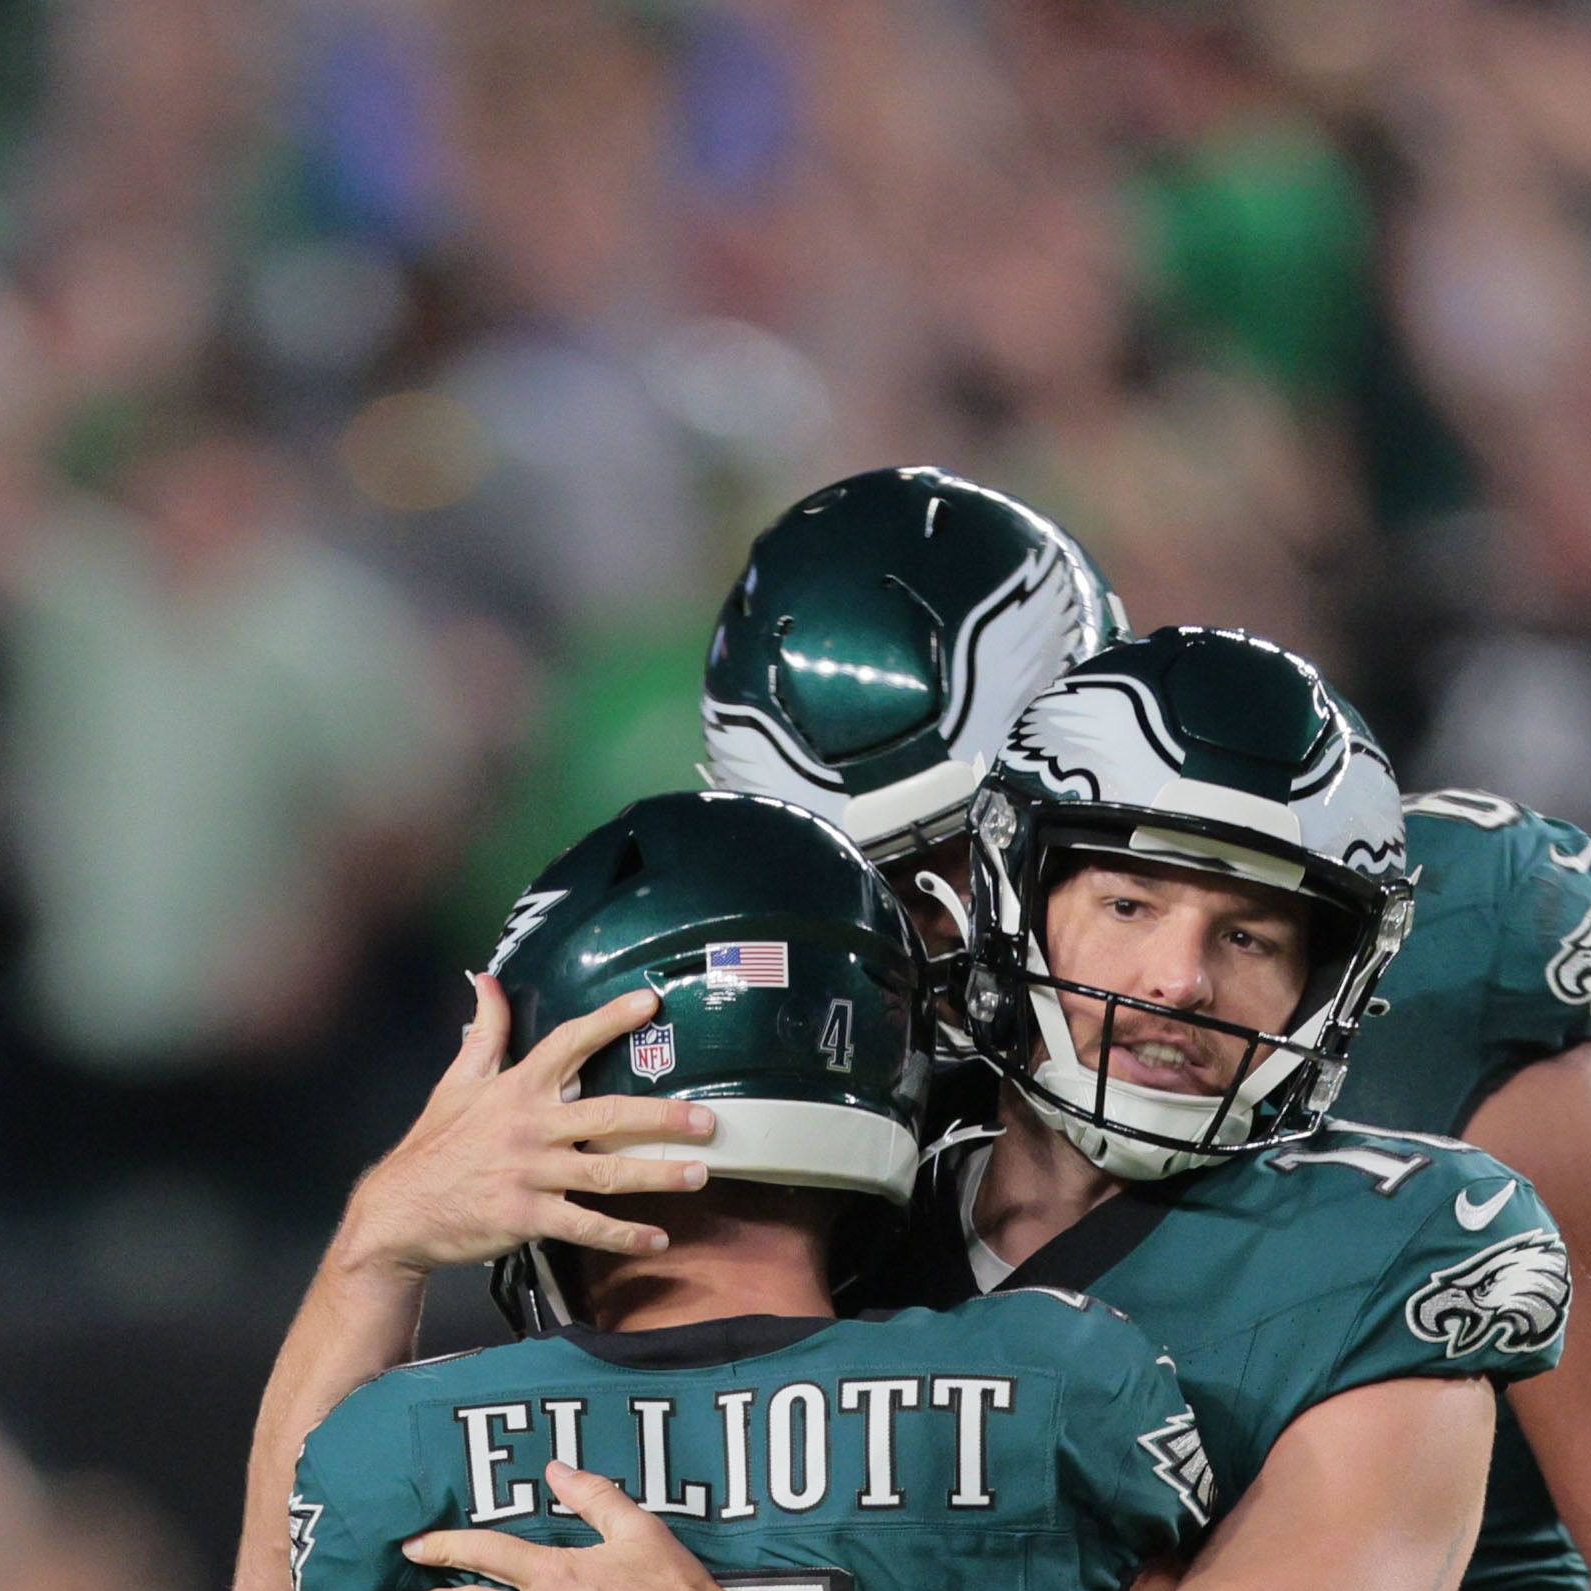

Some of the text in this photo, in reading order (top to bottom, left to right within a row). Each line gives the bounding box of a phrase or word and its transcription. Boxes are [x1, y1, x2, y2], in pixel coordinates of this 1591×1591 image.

[637, 1046, 669, 1070] NFL
[818, 998, 855, 1073] 4
[453, 1373, 1018, 1526] ELLIOTT
